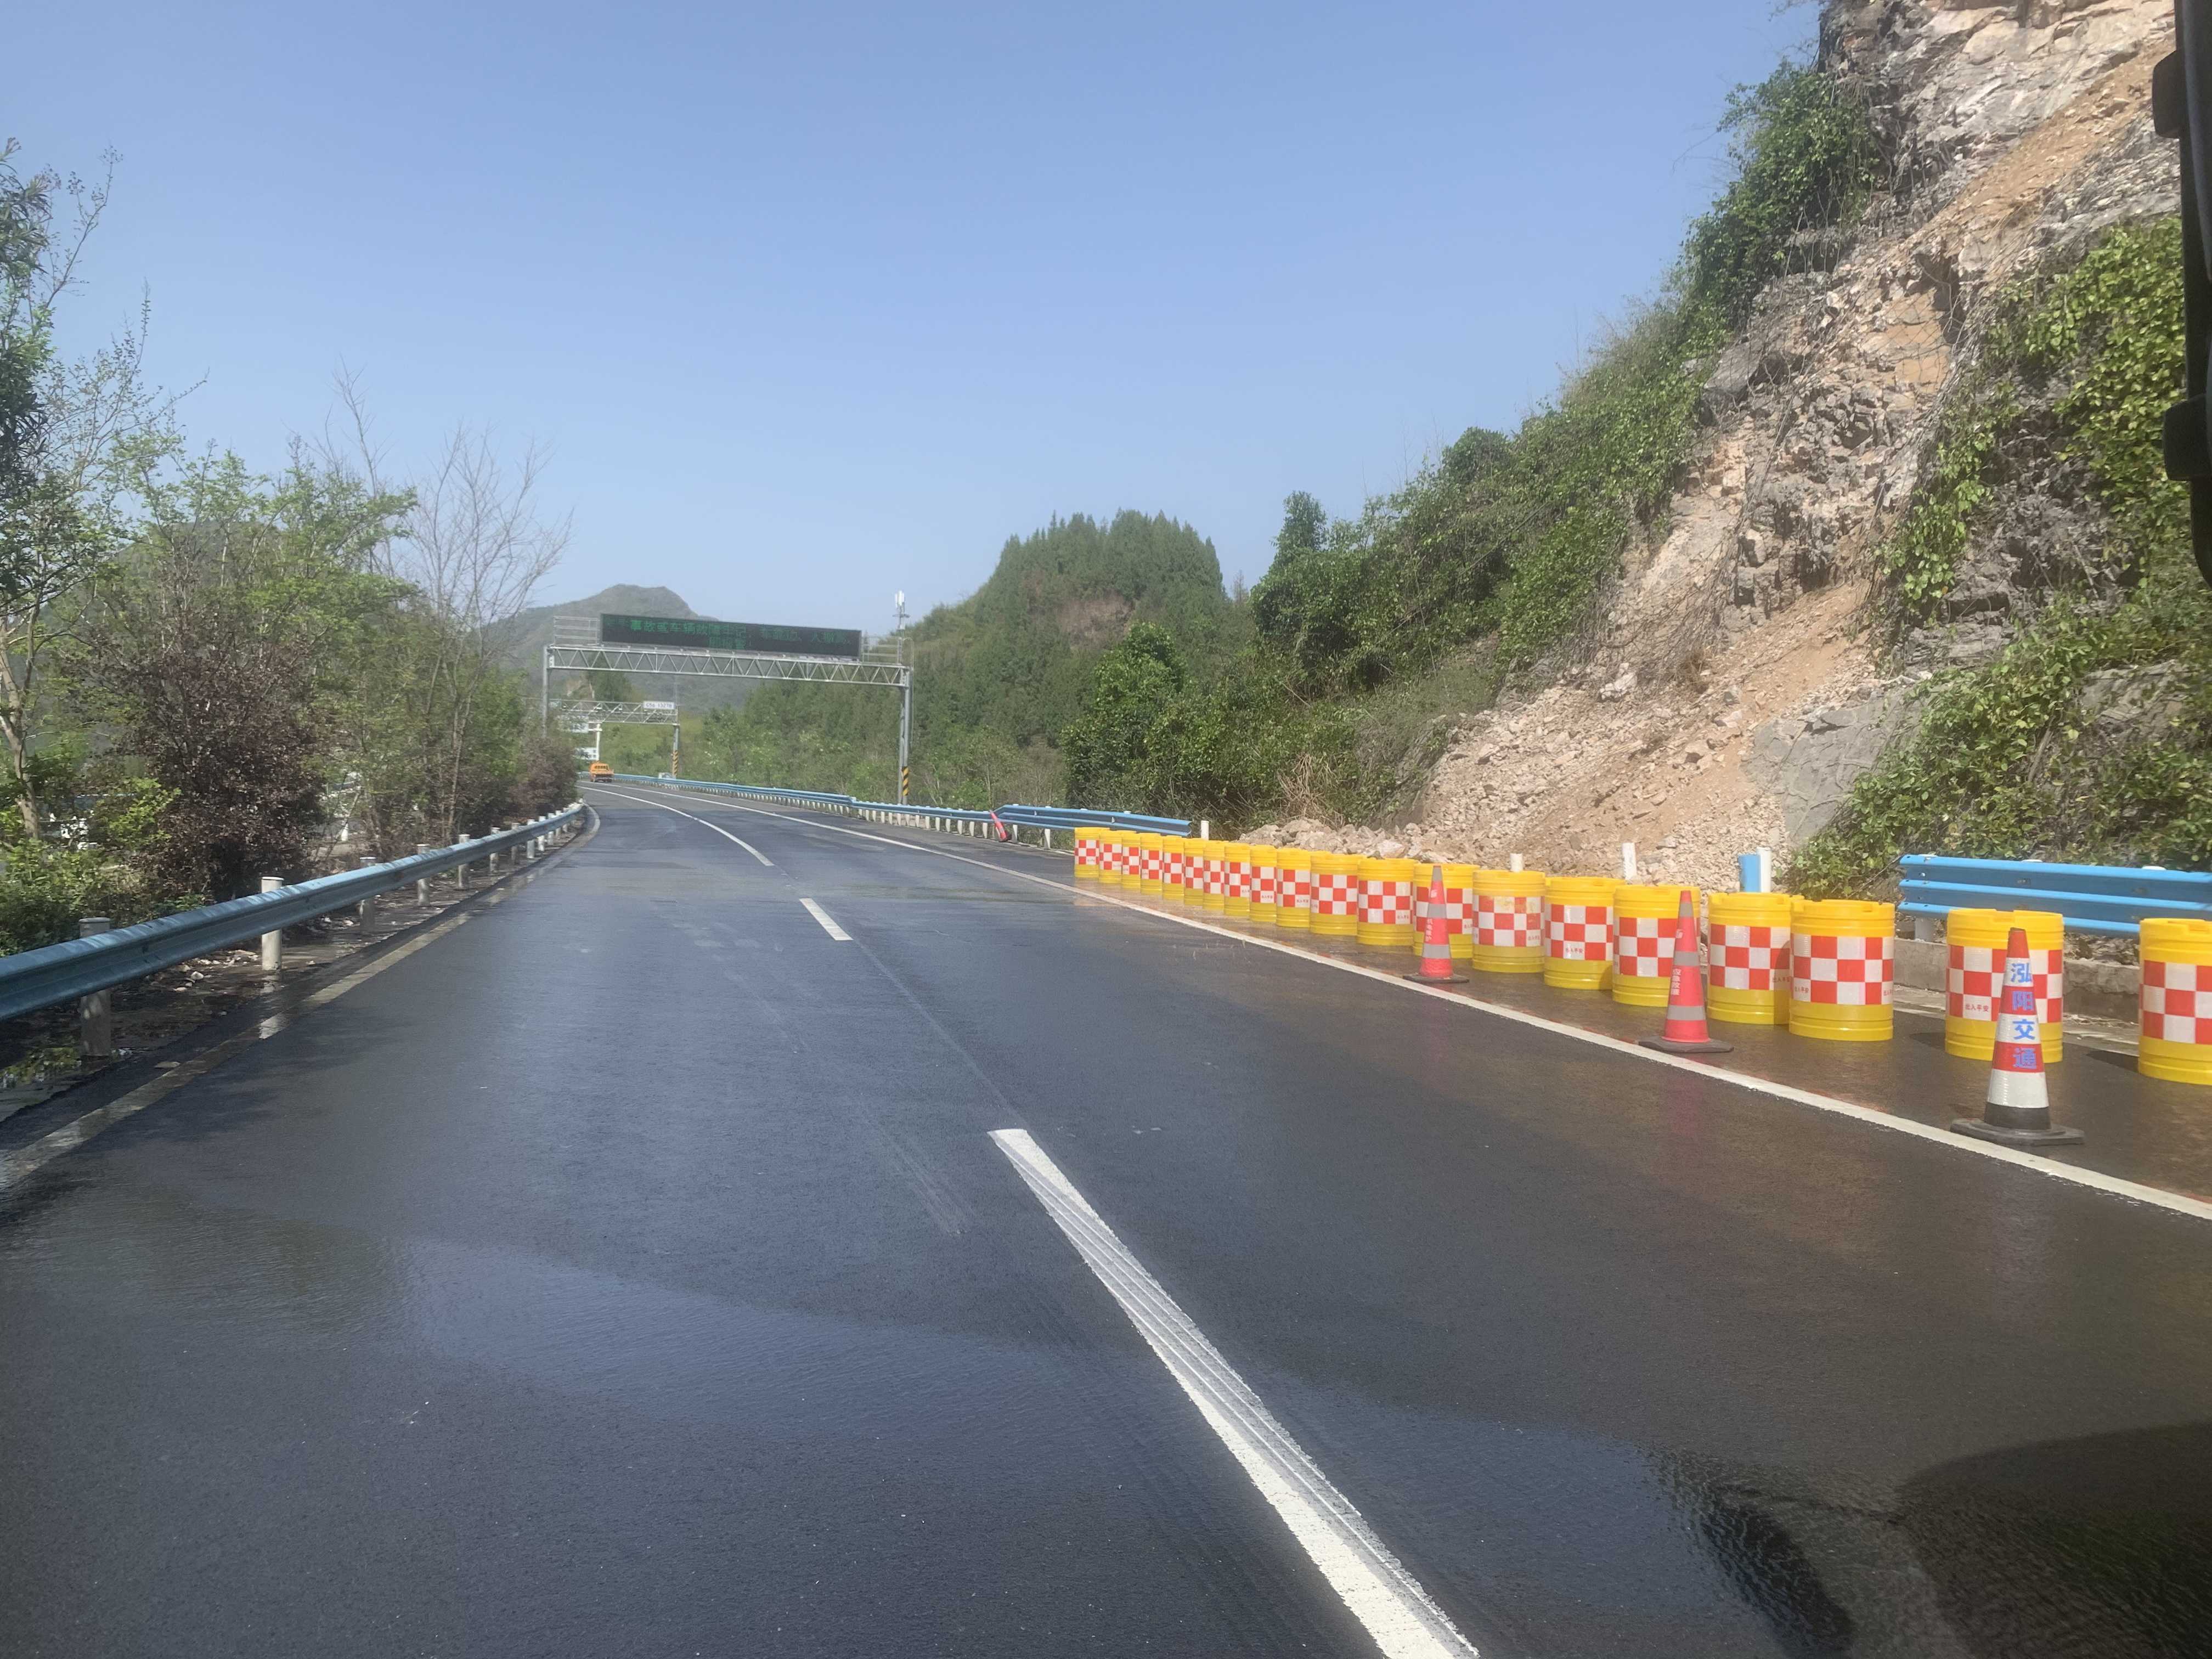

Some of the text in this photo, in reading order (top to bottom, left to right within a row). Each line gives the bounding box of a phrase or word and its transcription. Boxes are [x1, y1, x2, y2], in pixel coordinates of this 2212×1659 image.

[1966, 1003, 1989, 1012] 出入平安
[2010, 962, 2037, 1069] 泓阳交通
